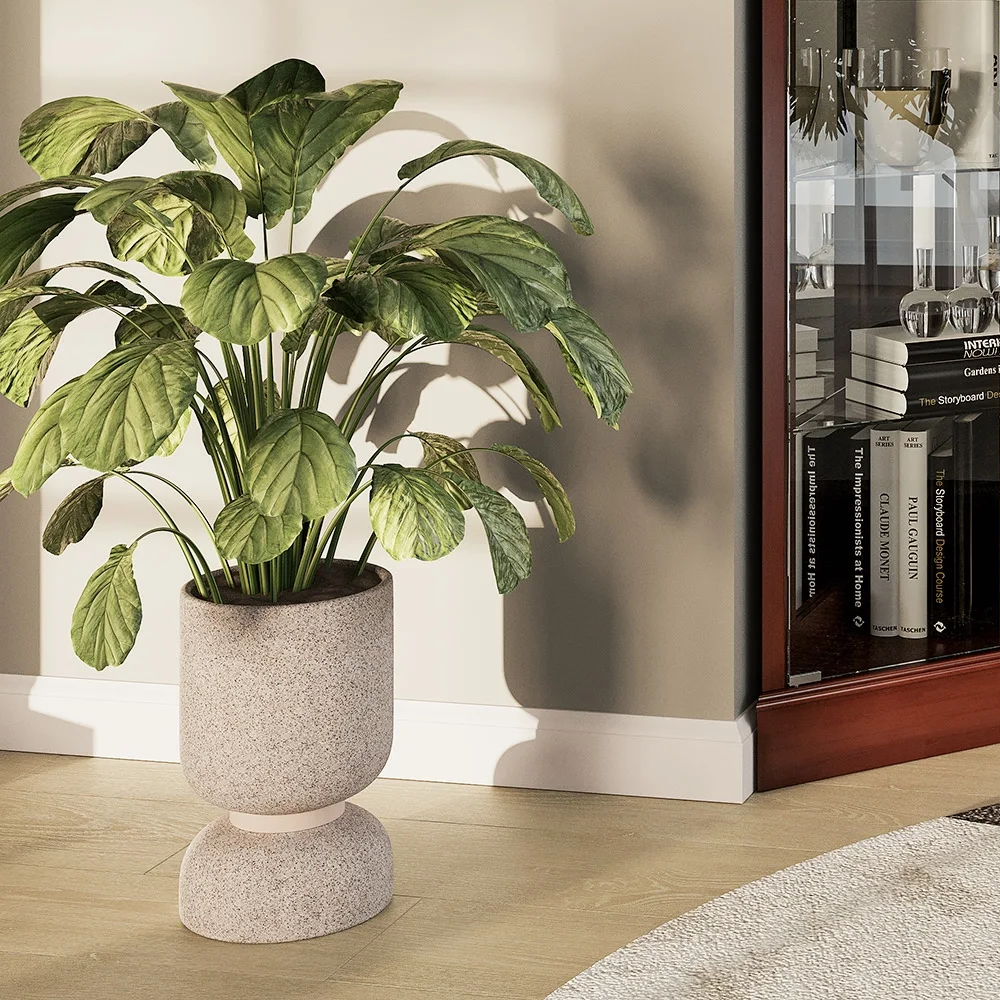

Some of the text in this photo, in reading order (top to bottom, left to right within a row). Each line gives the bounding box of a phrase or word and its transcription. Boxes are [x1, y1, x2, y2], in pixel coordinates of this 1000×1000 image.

[963, 366, 997, 377] Gardens
[919, 397, 937, 407] The
[938, 391, 985, 406] Storyboard
[853, 447, 864, 608] The Impressionists at Home
[879, 493, 890, 581] CLAUDE MONET
[908, 496, 919, 580] PAUL GAUGUIN
[933, 469, 946, 604] The Storyboard Design Course
[872, 624, 898, 632] TASCHEN
[900, 626, 926, 634] TASCHEN
